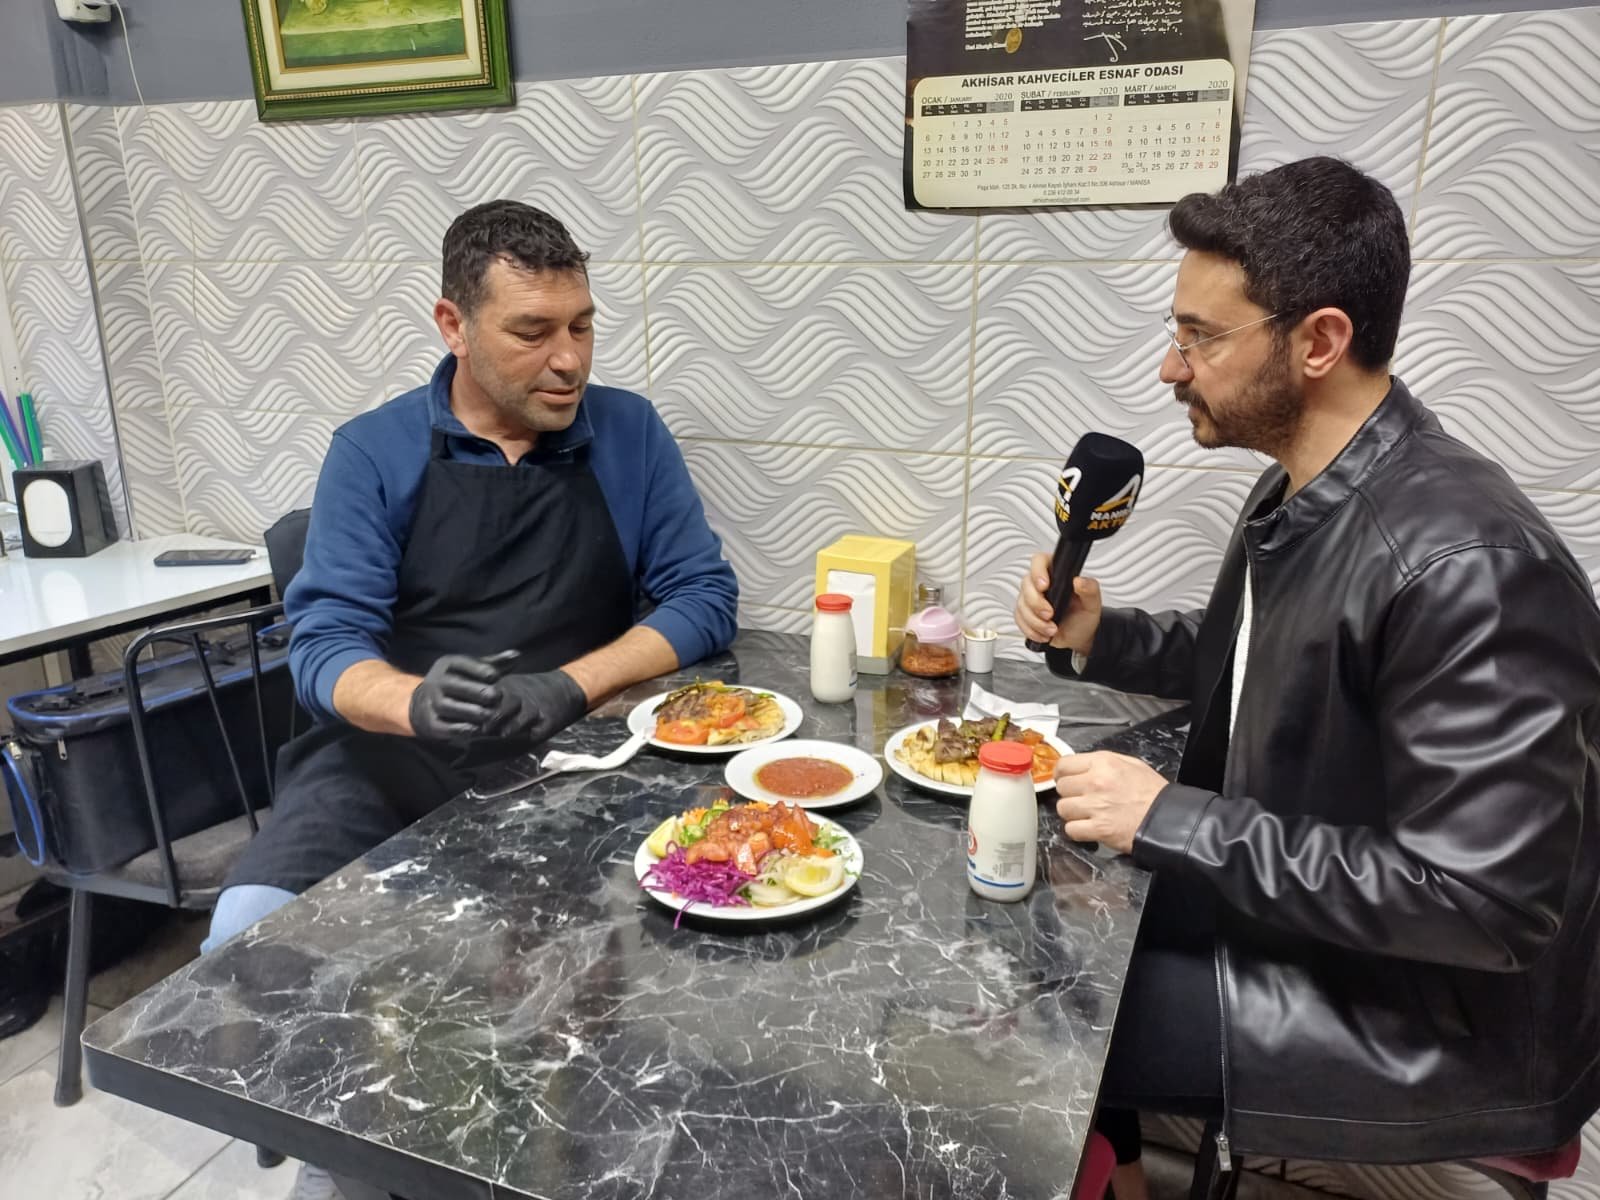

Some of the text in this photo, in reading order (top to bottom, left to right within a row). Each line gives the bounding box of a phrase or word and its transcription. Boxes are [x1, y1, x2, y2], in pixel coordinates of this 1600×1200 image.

[962, 65, 1183, 88] AKHİSAR KAHVECİLER ESNAF ODASI
[1099, 86, 1118, 95] 2020
